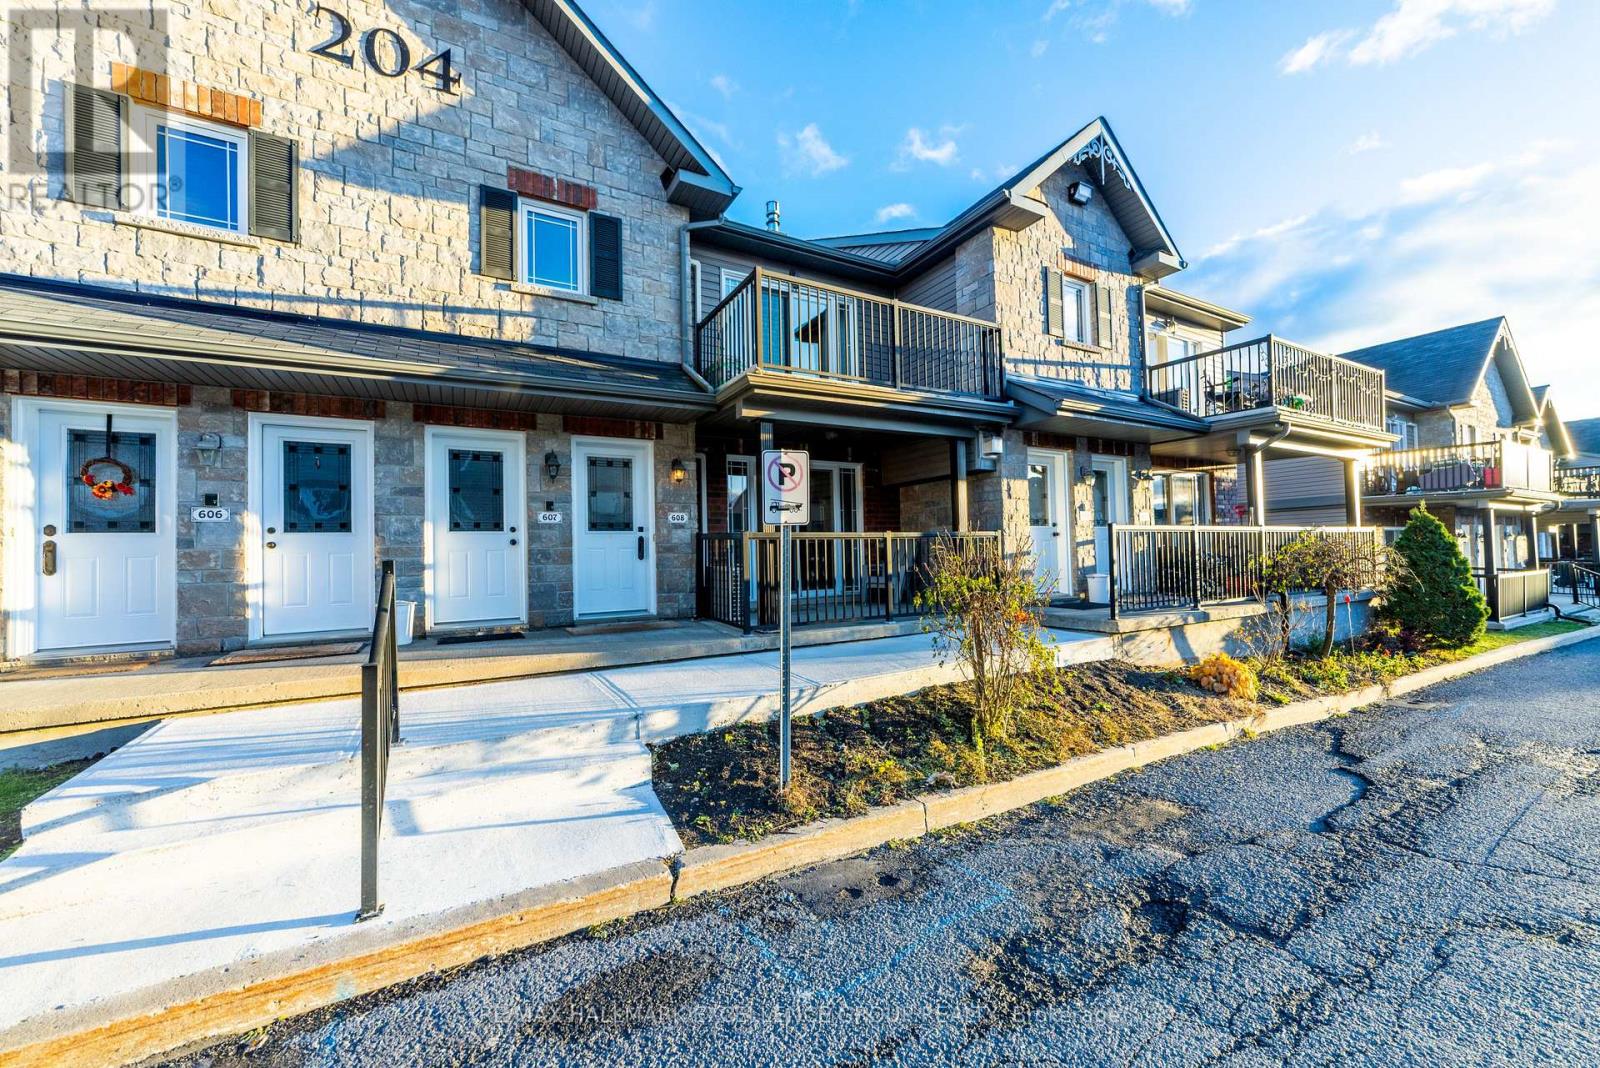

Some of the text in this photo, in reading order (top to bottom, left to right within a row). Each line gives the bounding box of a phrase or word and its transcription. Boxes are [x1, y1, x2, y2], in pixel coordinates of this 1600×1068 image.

[309, 2, 461, 96] 204
[778, 463, 796, 486] P
[198, 510, 223, 519] 606
[542, 513, 558, 521] 607
[671, 514, 685, 522] 608
